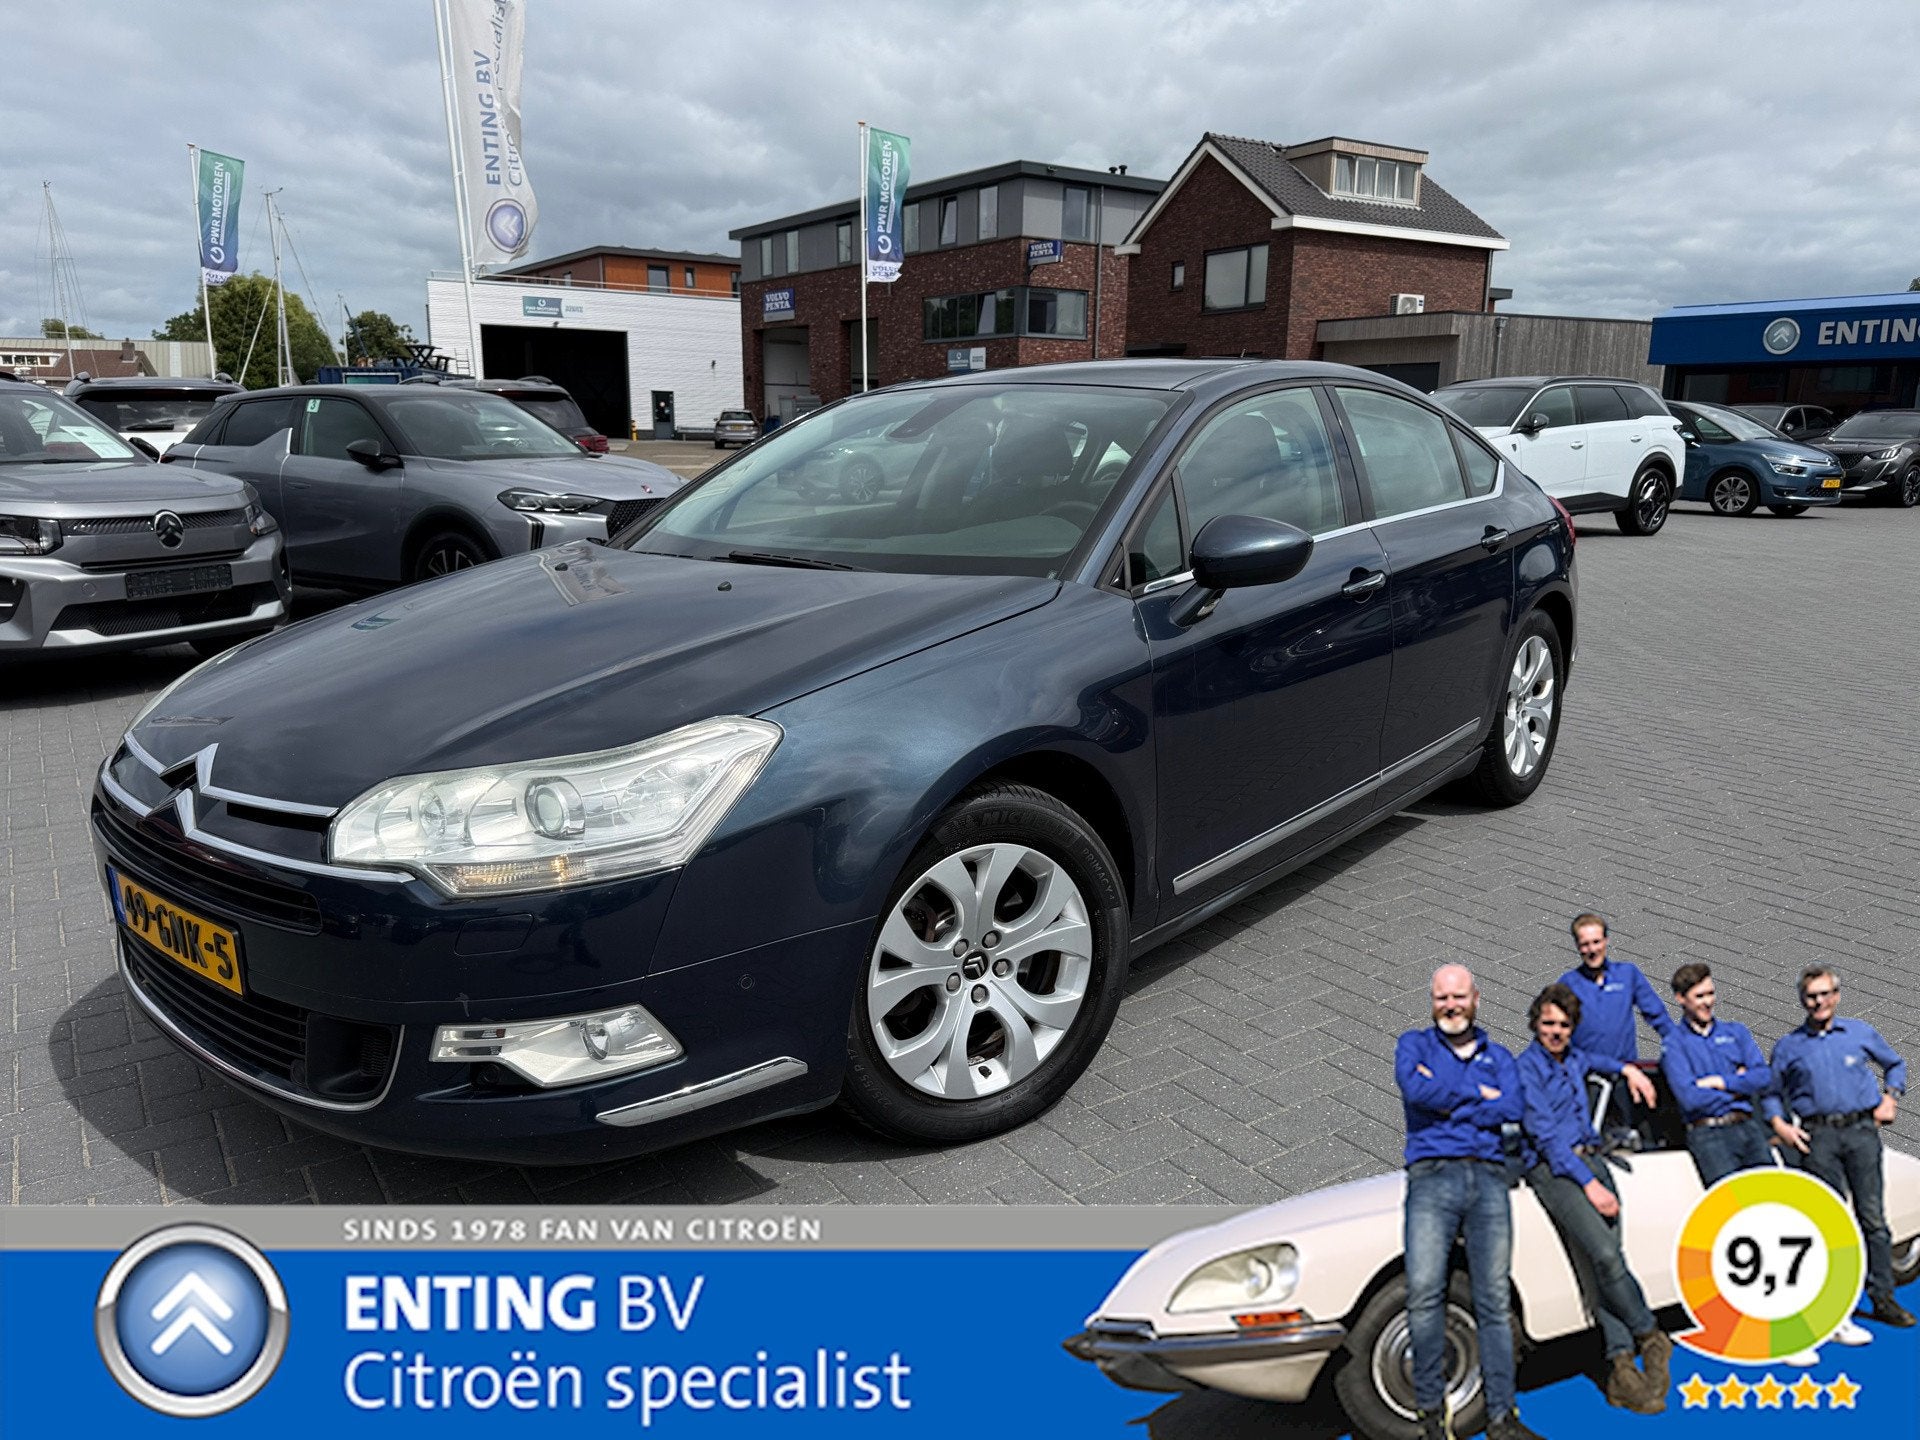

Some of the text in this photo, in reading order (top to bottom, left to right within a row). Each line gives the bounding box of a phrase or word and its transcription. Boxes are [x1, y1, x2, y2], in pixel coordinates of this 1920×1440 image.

[473, 49, 500, 185] ENTING BV
[210, 161, 224, 245] PWR MOTOREN
[877, 140, 892, 233] PWR MOTOREN
[1030, 242, 1054, 251] VOLVO
[1030, 249, 1054, 257] PENTA
[765, 292, 790, 302] VOLVO
[765, 301, 791, 311] PENTA
[1817, 317, 1920, 345] ENTIN
[1083, 847, 1114, 894] PRIMACY
[125, 885, 233, 980] 49-GNK-5
